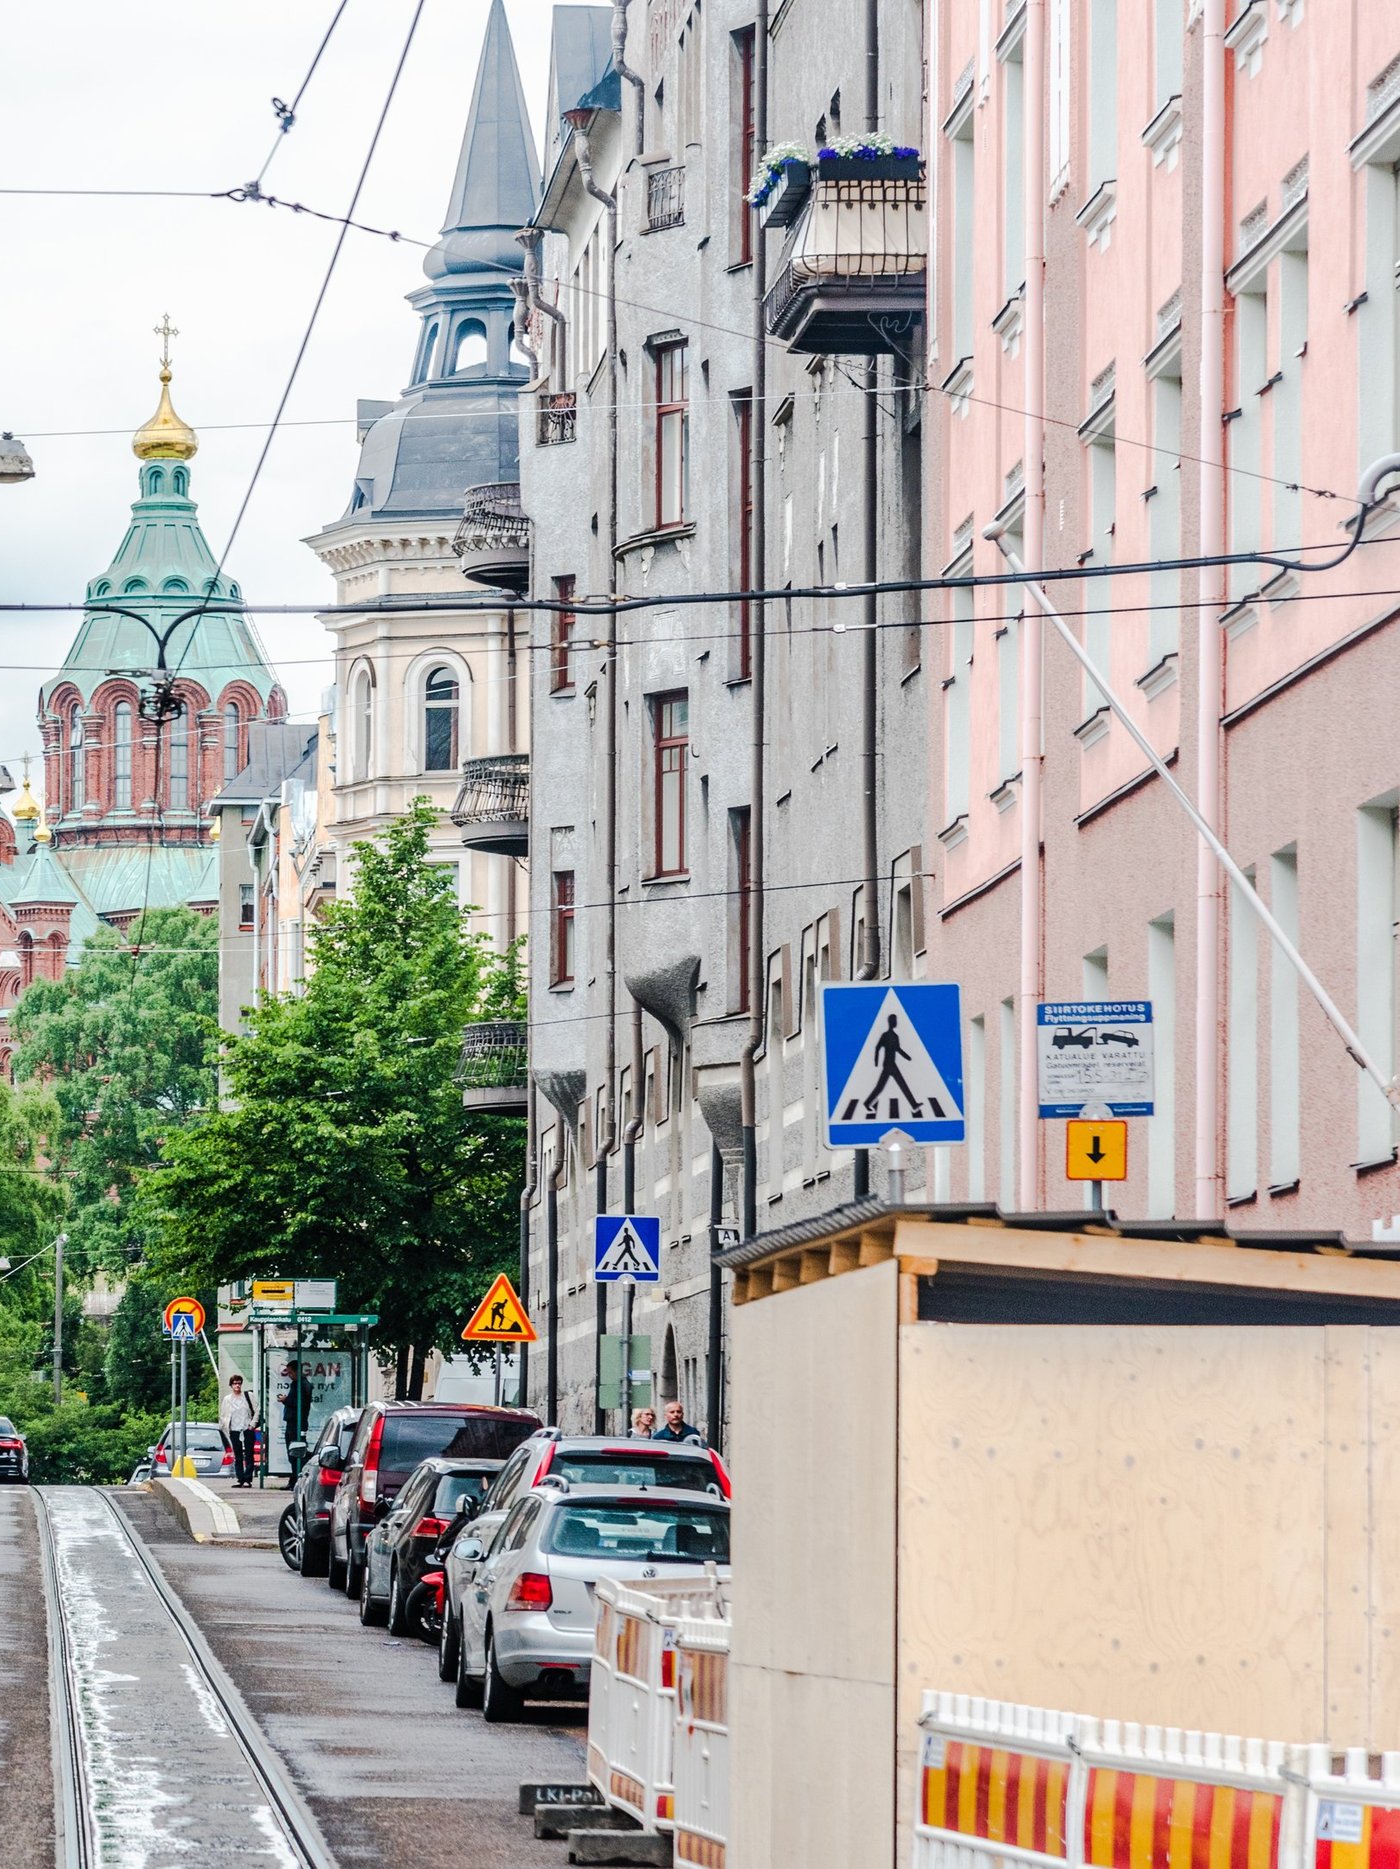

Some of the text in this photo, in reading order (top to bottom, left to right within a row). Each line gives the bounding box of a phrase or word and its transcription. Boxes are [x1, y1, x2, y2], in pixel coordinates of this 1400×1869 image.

[1044, 1003, 1145, 1014] SIIRTOKEHOTUS
[1044, 1013, 1145, 1023] Flyttningsuppmaning
[722, 1230, 731, 1240] A
